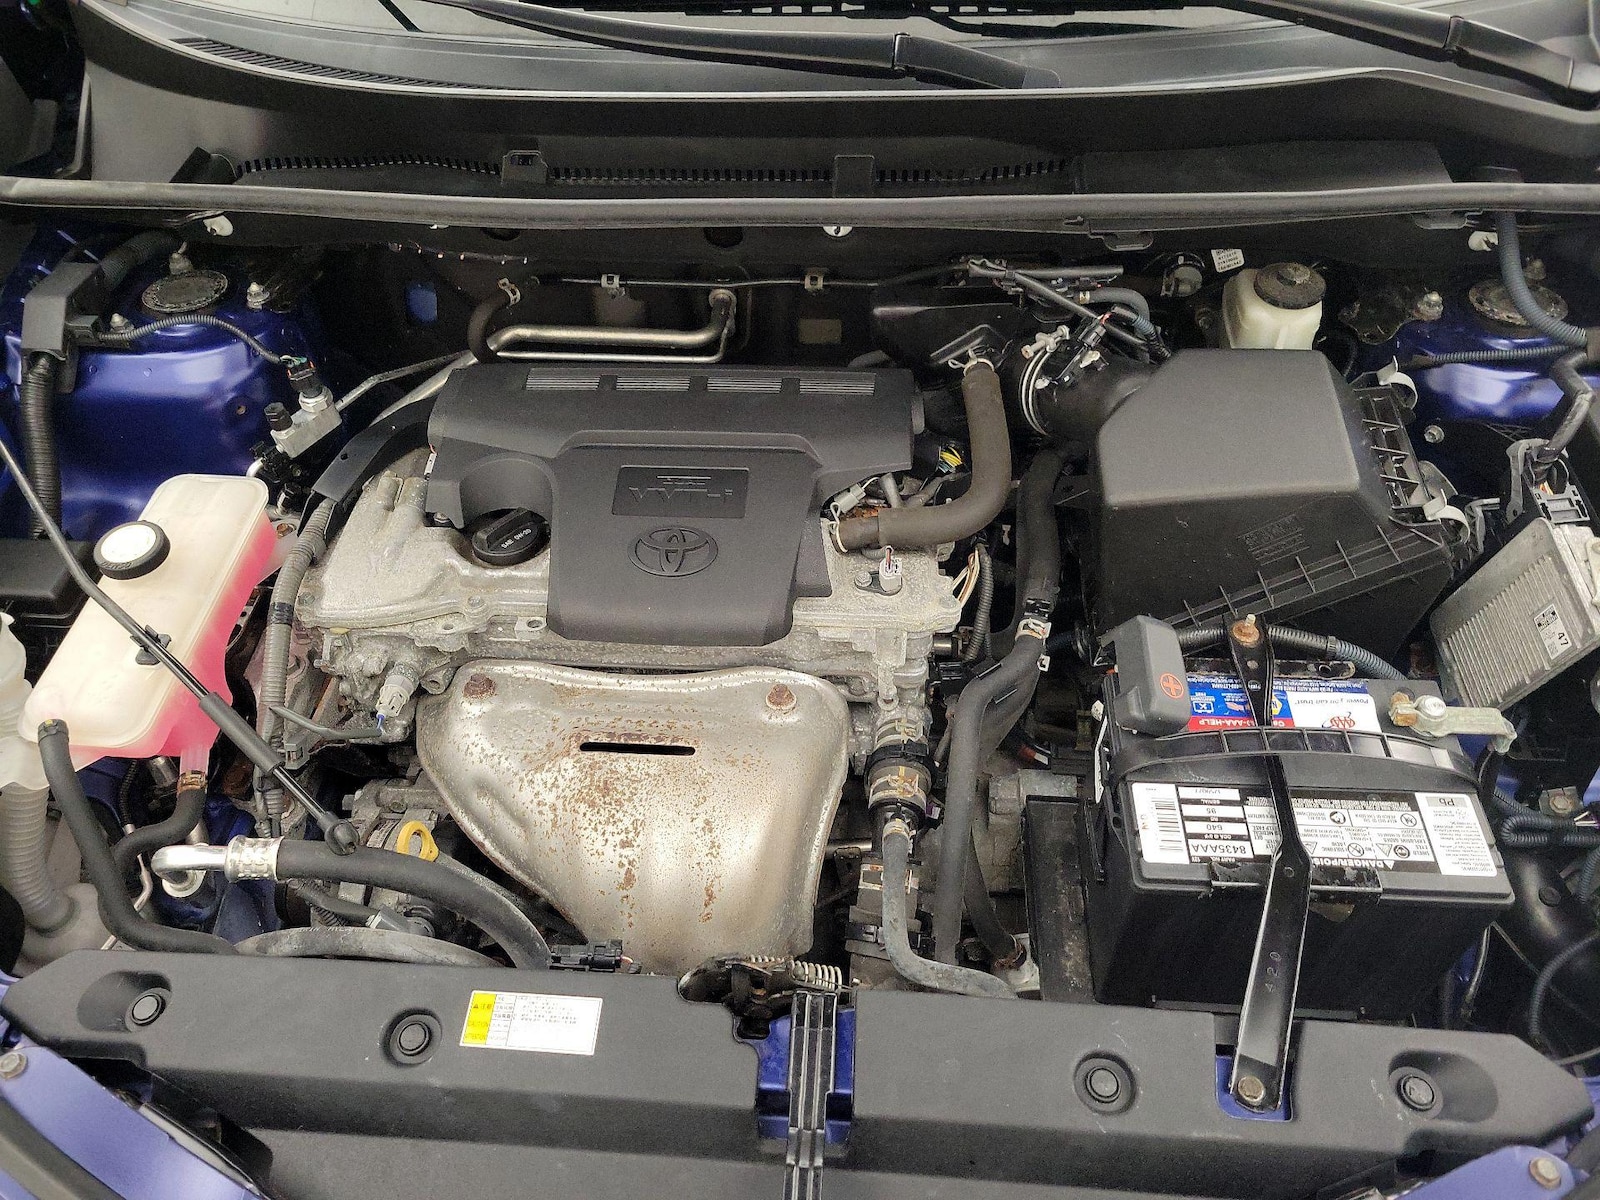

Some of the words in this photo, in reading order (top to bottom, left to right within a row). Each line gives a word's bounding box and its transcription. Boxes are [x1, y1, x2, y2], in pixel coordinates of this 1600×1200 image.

[1557, 632, 1569, 646] 47
[1439, 798, 1455, 806] Pb
[1191, 843, 1247, 855] 8435AAA
